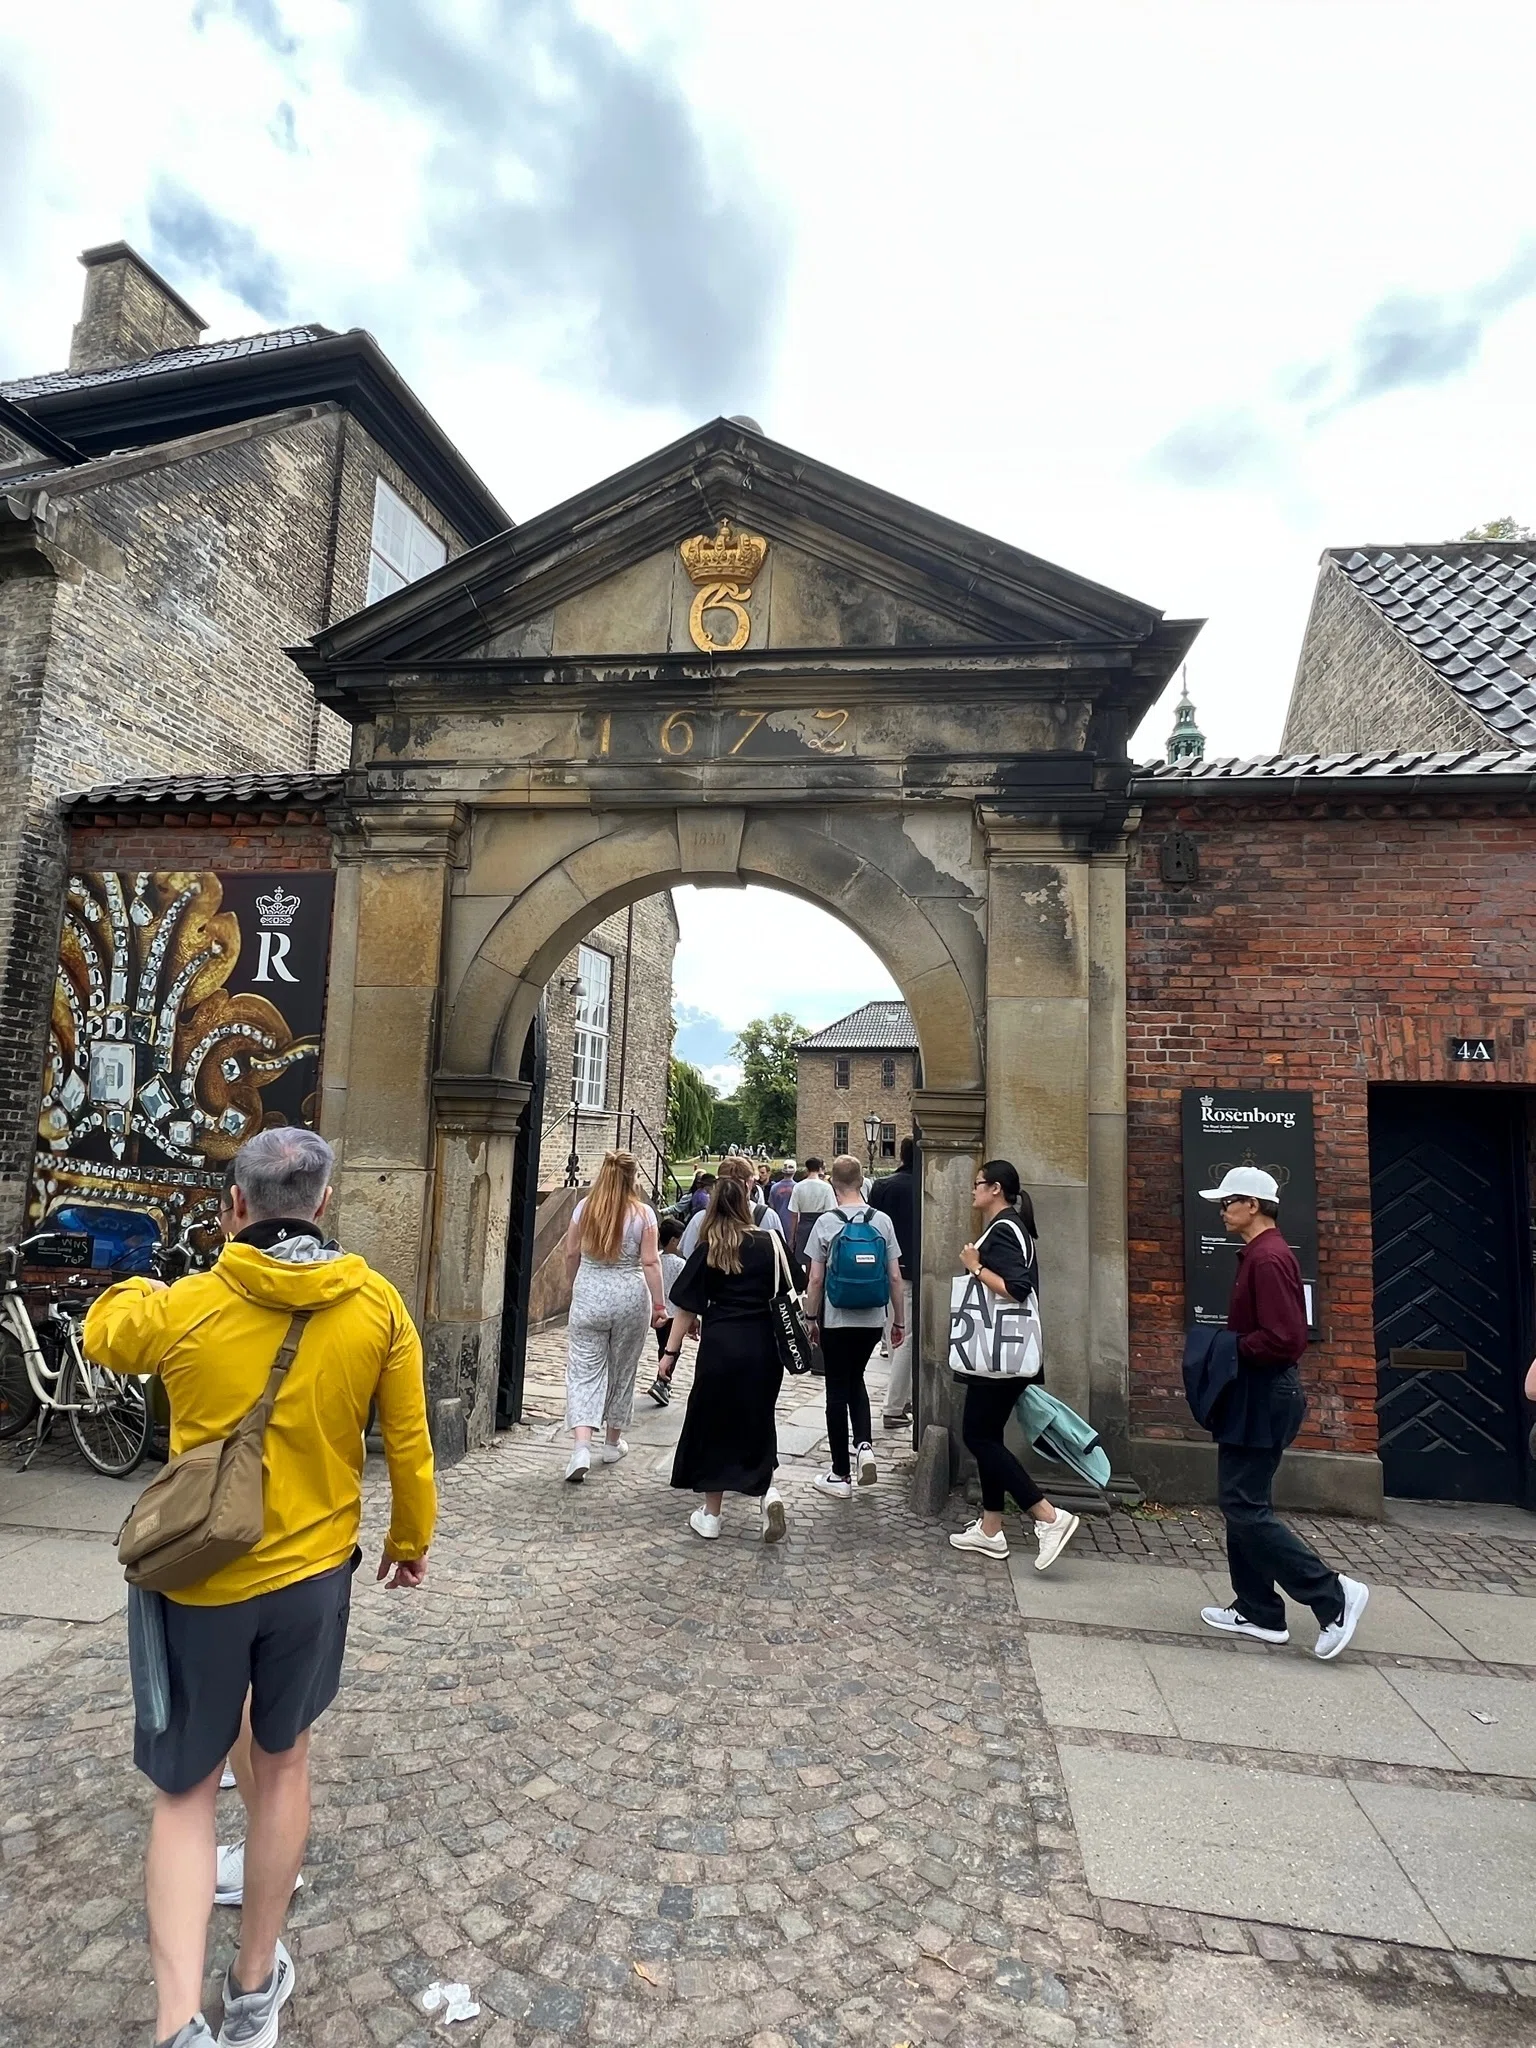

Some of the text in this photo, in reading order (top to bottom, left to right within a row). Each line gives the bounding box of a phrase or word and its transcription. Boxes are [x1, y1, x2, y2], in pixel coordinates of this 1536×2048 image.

[600, 709, 849, 756] 1672
[251, 931, 300, 982] R
[1457, 1041, 1490, 1060] 4A
[1200, 1106, 1296, 1128] Rosenborg
[778, 1303, 794, 1335] DAUNT
[787, 1338, 805, 1370] BOOKS
